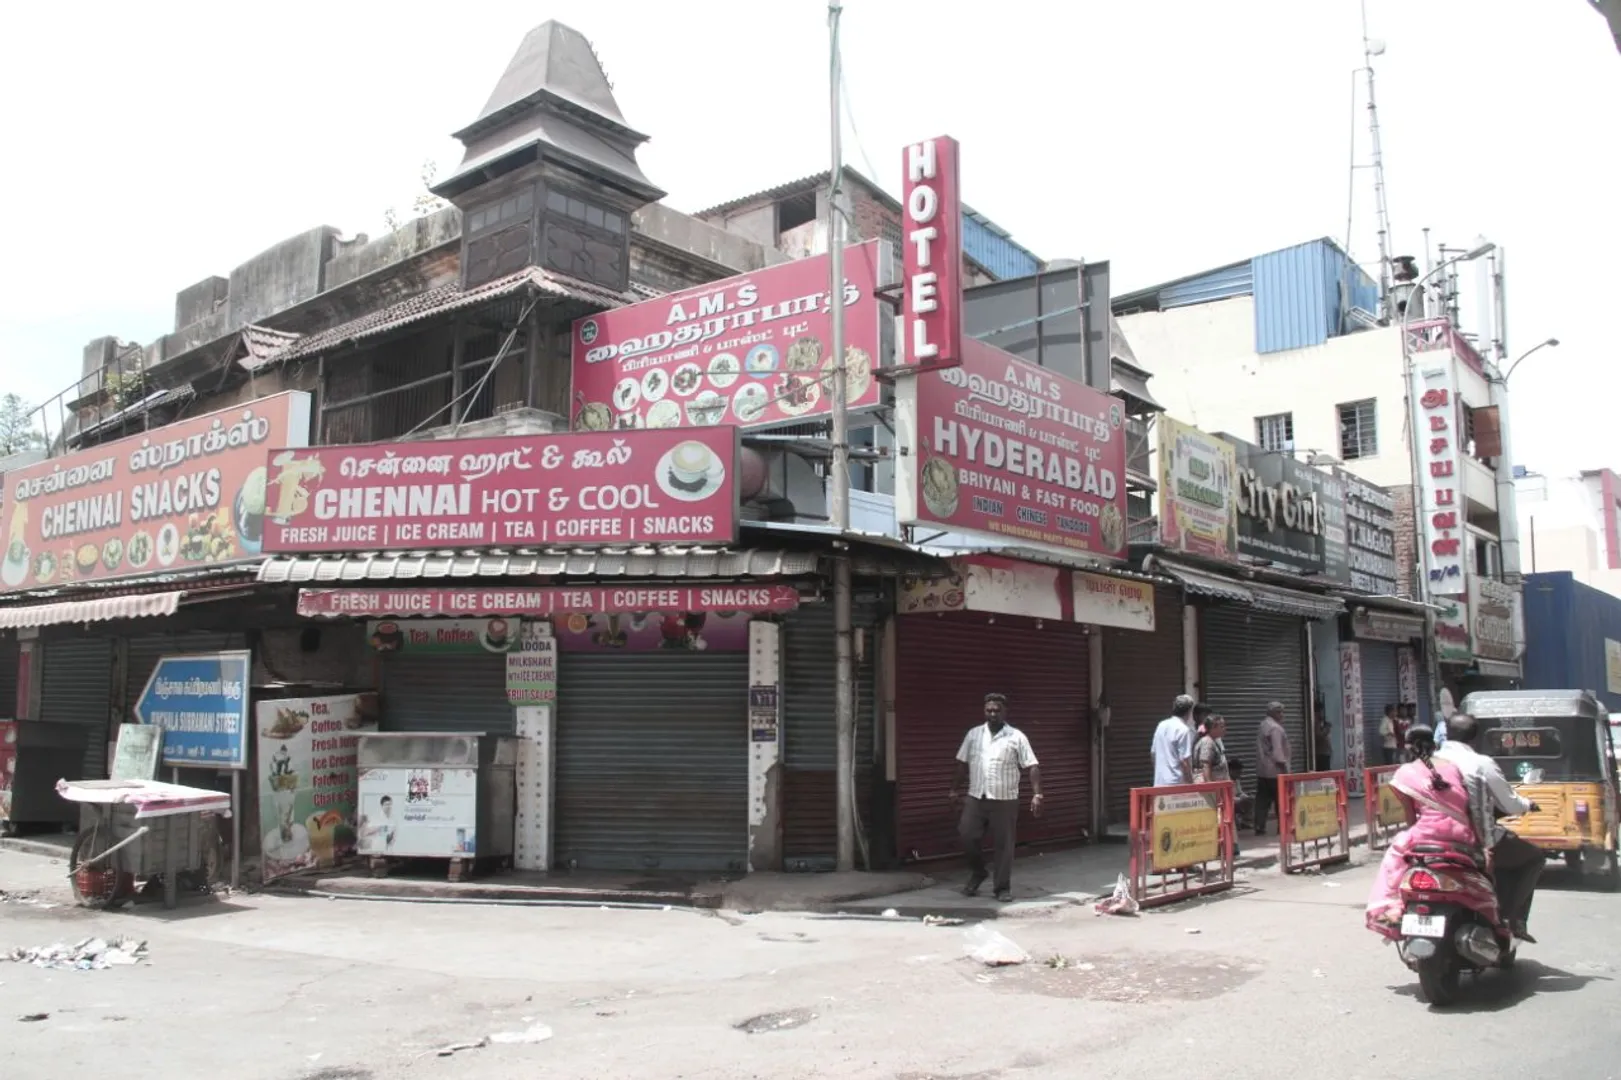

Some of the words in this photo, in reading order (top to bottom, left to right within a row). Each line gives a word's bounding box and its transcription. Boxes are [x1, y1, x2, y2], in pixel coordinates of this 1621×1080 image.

[908, 139, 938, 358] HOTEL
[666, 283, 760, 326] A.M.S
[1003, 364, 1062, 400] A.M.S
[15, 456, 117, 501] சென்னை
[129, 411, 270, 472] ஸ்நாக்ஸ்
[340, 450, 453, 478] சென்னை
[459, 446, 533, 482] ஹாட்
[542, 445, 564, 470] &
[572, 438, 633, 467] கூல்
[933, 416, 1117, 501] HYDERABAD
[40, 490, 123, 539] CHENNAI
[130, 468, 222, 522] SNACKS
[313, 483, 471, 520] CHENNAI
[481, 487, 540, 514] HOT
[548, 486, 571, 511] &
[577, 483, 660, 511] COOL
[959, 468, 1016, 497] BRIYANI
[1021, 486, 1031, 501] &
[1036, 488, 1065, 510] FAST
[1069, 498, 1100, 518] FOOD
[1236, 466, 1279, 533] City
[1281, 481, 1326, 537] Girls
[973, 495, 1004, 517] INDIAN
[1015, 504, 1048, 527] CHINESE
[280, 526, 328, 544] FRESH
[332, 524, 377, 543] JUICE
[395, 522, 424, 541] ICE
[426, 521, 485, 540] CREAM
[504, 519, 535, 538] TEA
[555, 517, 622, 537] COFFEE
[643, 515, 715, 536] SNACKS
[330, 593, 380, 611] FRESH
[383, 593, 432, 610] JUICE
[450, 592, 478, 609] ICE
[482, 591, 541, 609] CREAM
[562, 591, 593, 608] TEA
[613, 589, 679, 608] COFFEE
[700, 588, 770, 607] SNACKS
[409, 628, 430, 645] Tea
[436, 627, 476, 644] Coffee
[508, 656, 553, 668] MILKSHAKE
[507, 688, 529, 701] FRUIT
[216, 712, 241, 734] STREET
[311, 719, 343, 735] Coffee
[311, 739, 338, 752] Fresh
[339, 735, 359, 749] Juic
[312, 755, 328, 770] Ice
